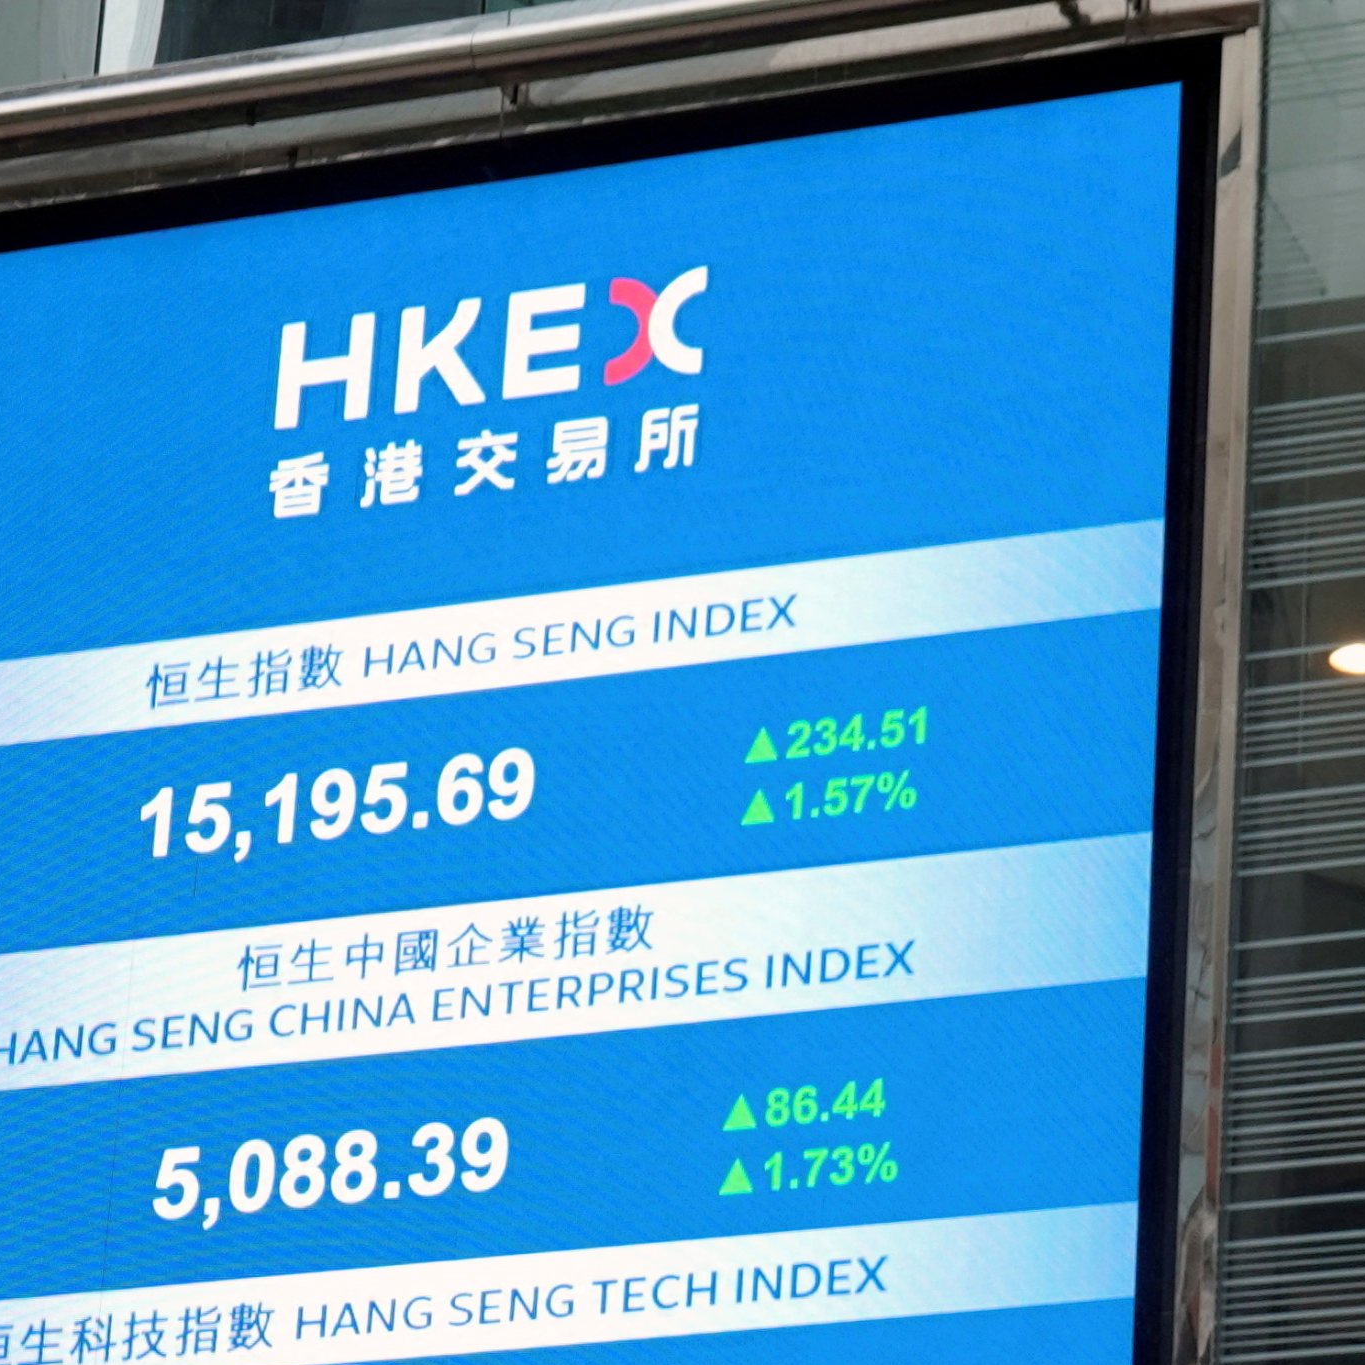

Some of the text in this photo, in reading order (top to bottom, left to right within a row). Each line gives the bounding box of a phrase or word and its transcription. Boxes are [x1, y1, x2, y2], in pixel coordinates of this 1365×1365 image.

[274, 265, 708, 430] HKEX
[269, 403, 700, 519] 香港交易所
[145, 593, 798, 712] 恒生指數 HANG SENG INDEX
[785, 706, 928, 760] 234.51
[140, 747, 535, 863] 15,195.69
[784, 770, 918, 823] 1.57%
[130, 1008, 254, 1053] SENG
[269, 992, 416, 1039] CHINA
[431, 956, 750, 1023] ENTERPRISES
[764, 938, 916, 990] INDEX
[237, 903, 655, 993] 恒生中國企業指數
[763, 1077, 887, 1128] 86.44
[151, 1117, 509, 1230] 5,088.39
[762, 1142, 898, 1193] 1.73%
[295, 1295, 433, 1341] HANG
[448, 1283, 575, 1327] SENG
[591, 1269, 719, 1315] TECH
[734, 1254, 889, 1305] INDEX
